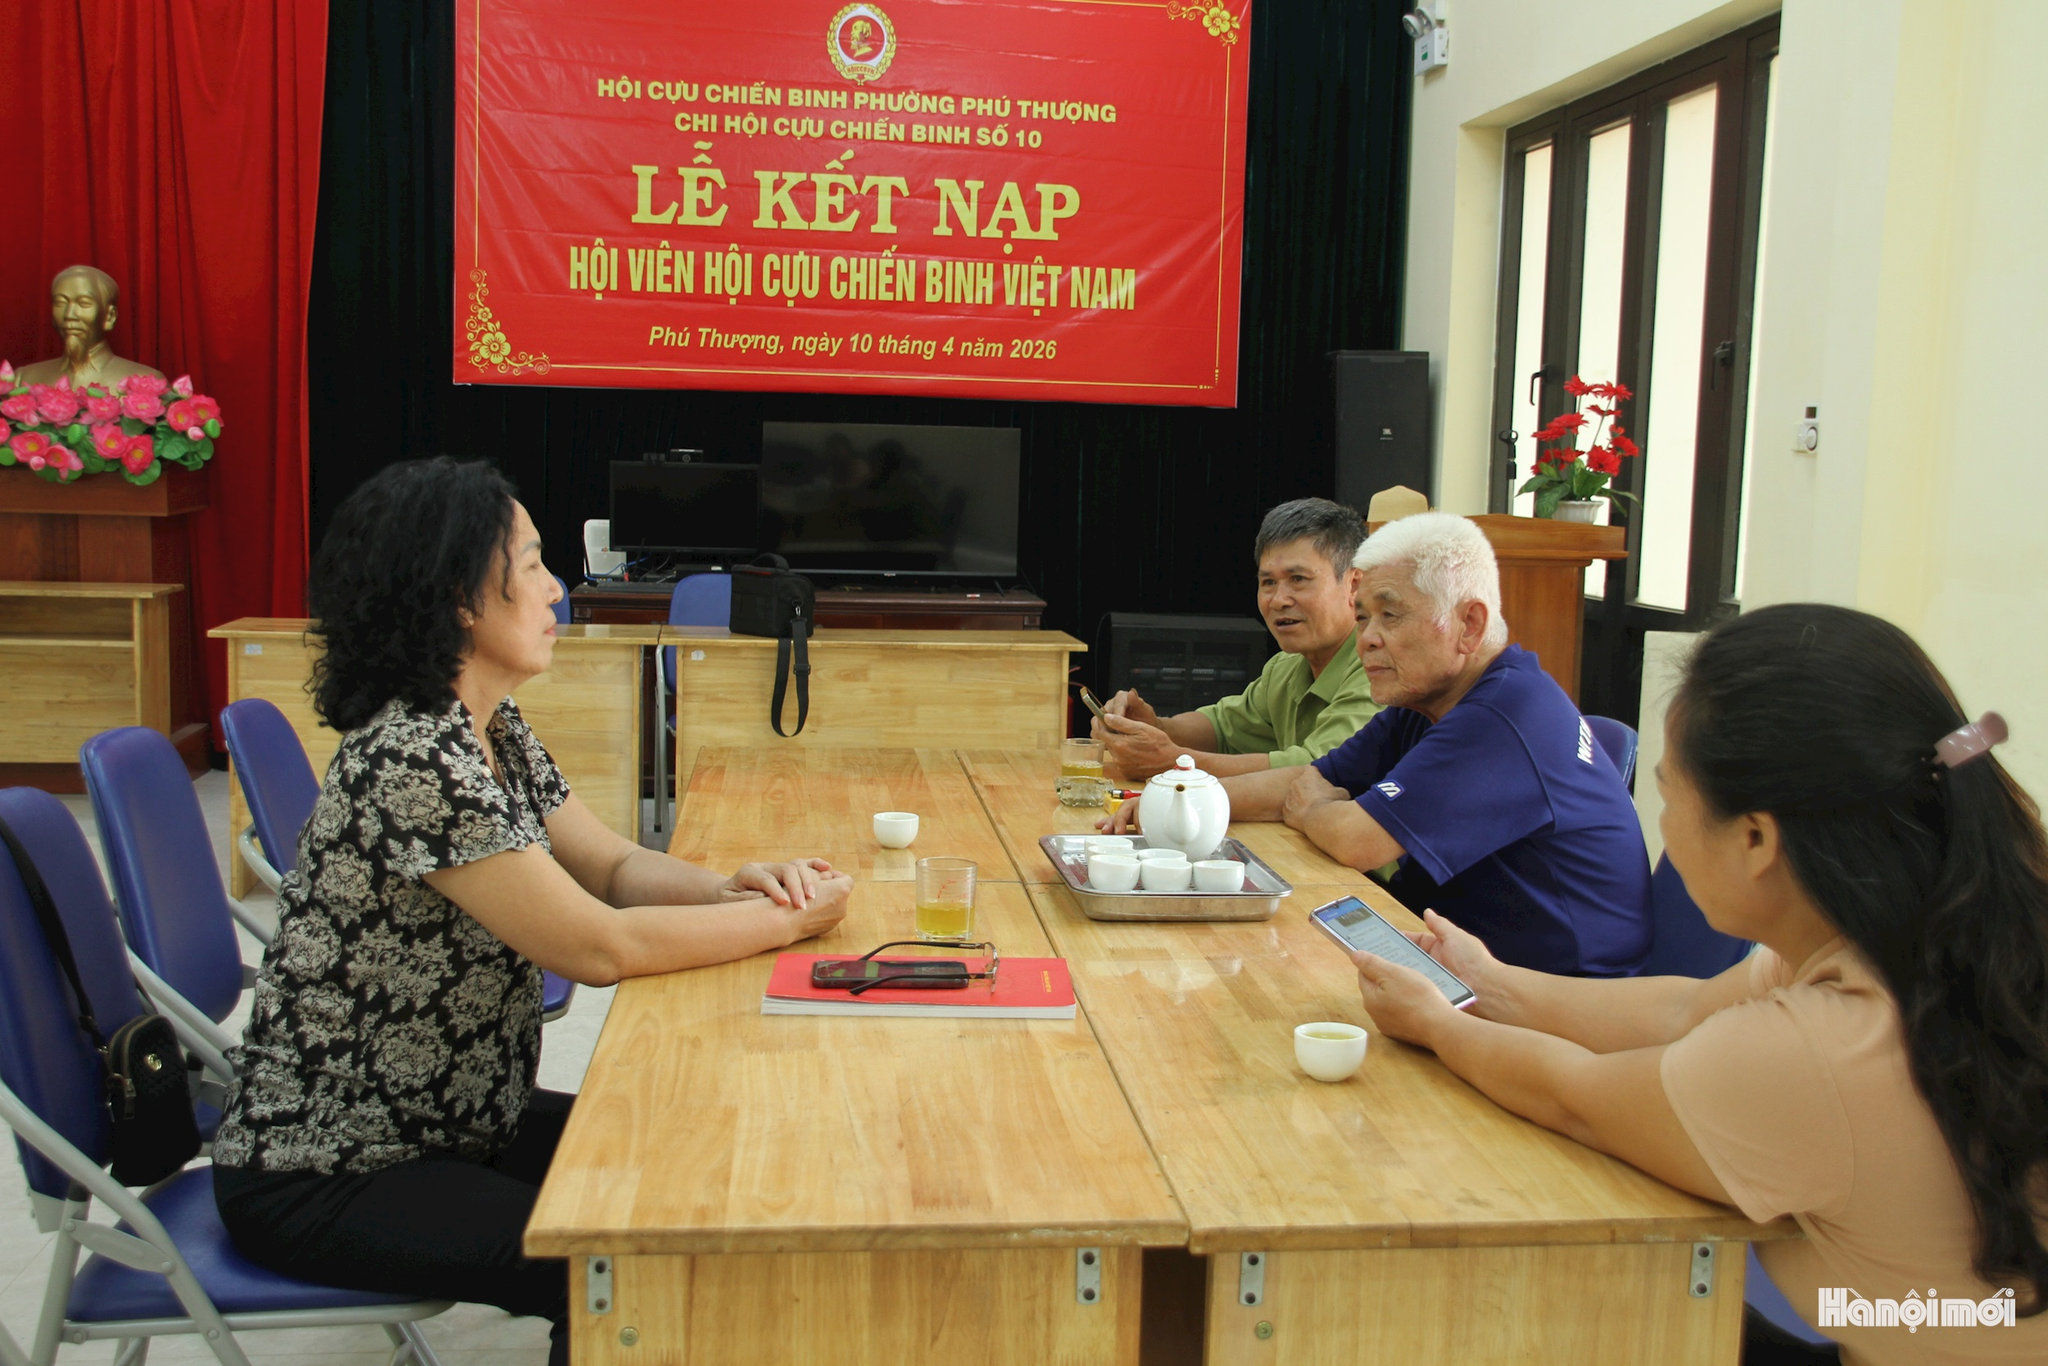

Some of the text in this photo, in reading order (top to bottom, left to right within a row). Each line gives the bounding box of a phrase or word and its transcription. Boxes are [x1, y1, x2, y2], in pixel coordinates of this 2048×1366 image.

[597, 76, 1117, 124] HỘI CỰU CHIẾN BINH PHƯỜNG PHÚ THƯỢNG
[674, 112, 1042, 148] CHI HỘI CỰU CHIẾN BINH SỐ 10
[631, 141, 1081, 254] LỄ KẾT NẠP
[569, 238, 1137, 316] HỘI VIÊN HỘI CỰU CHIẾN BINH VIỆT NAM
[648, 327, 1057, 360] Phú Thượng, ngày 10 tháng 4 năm 2026
